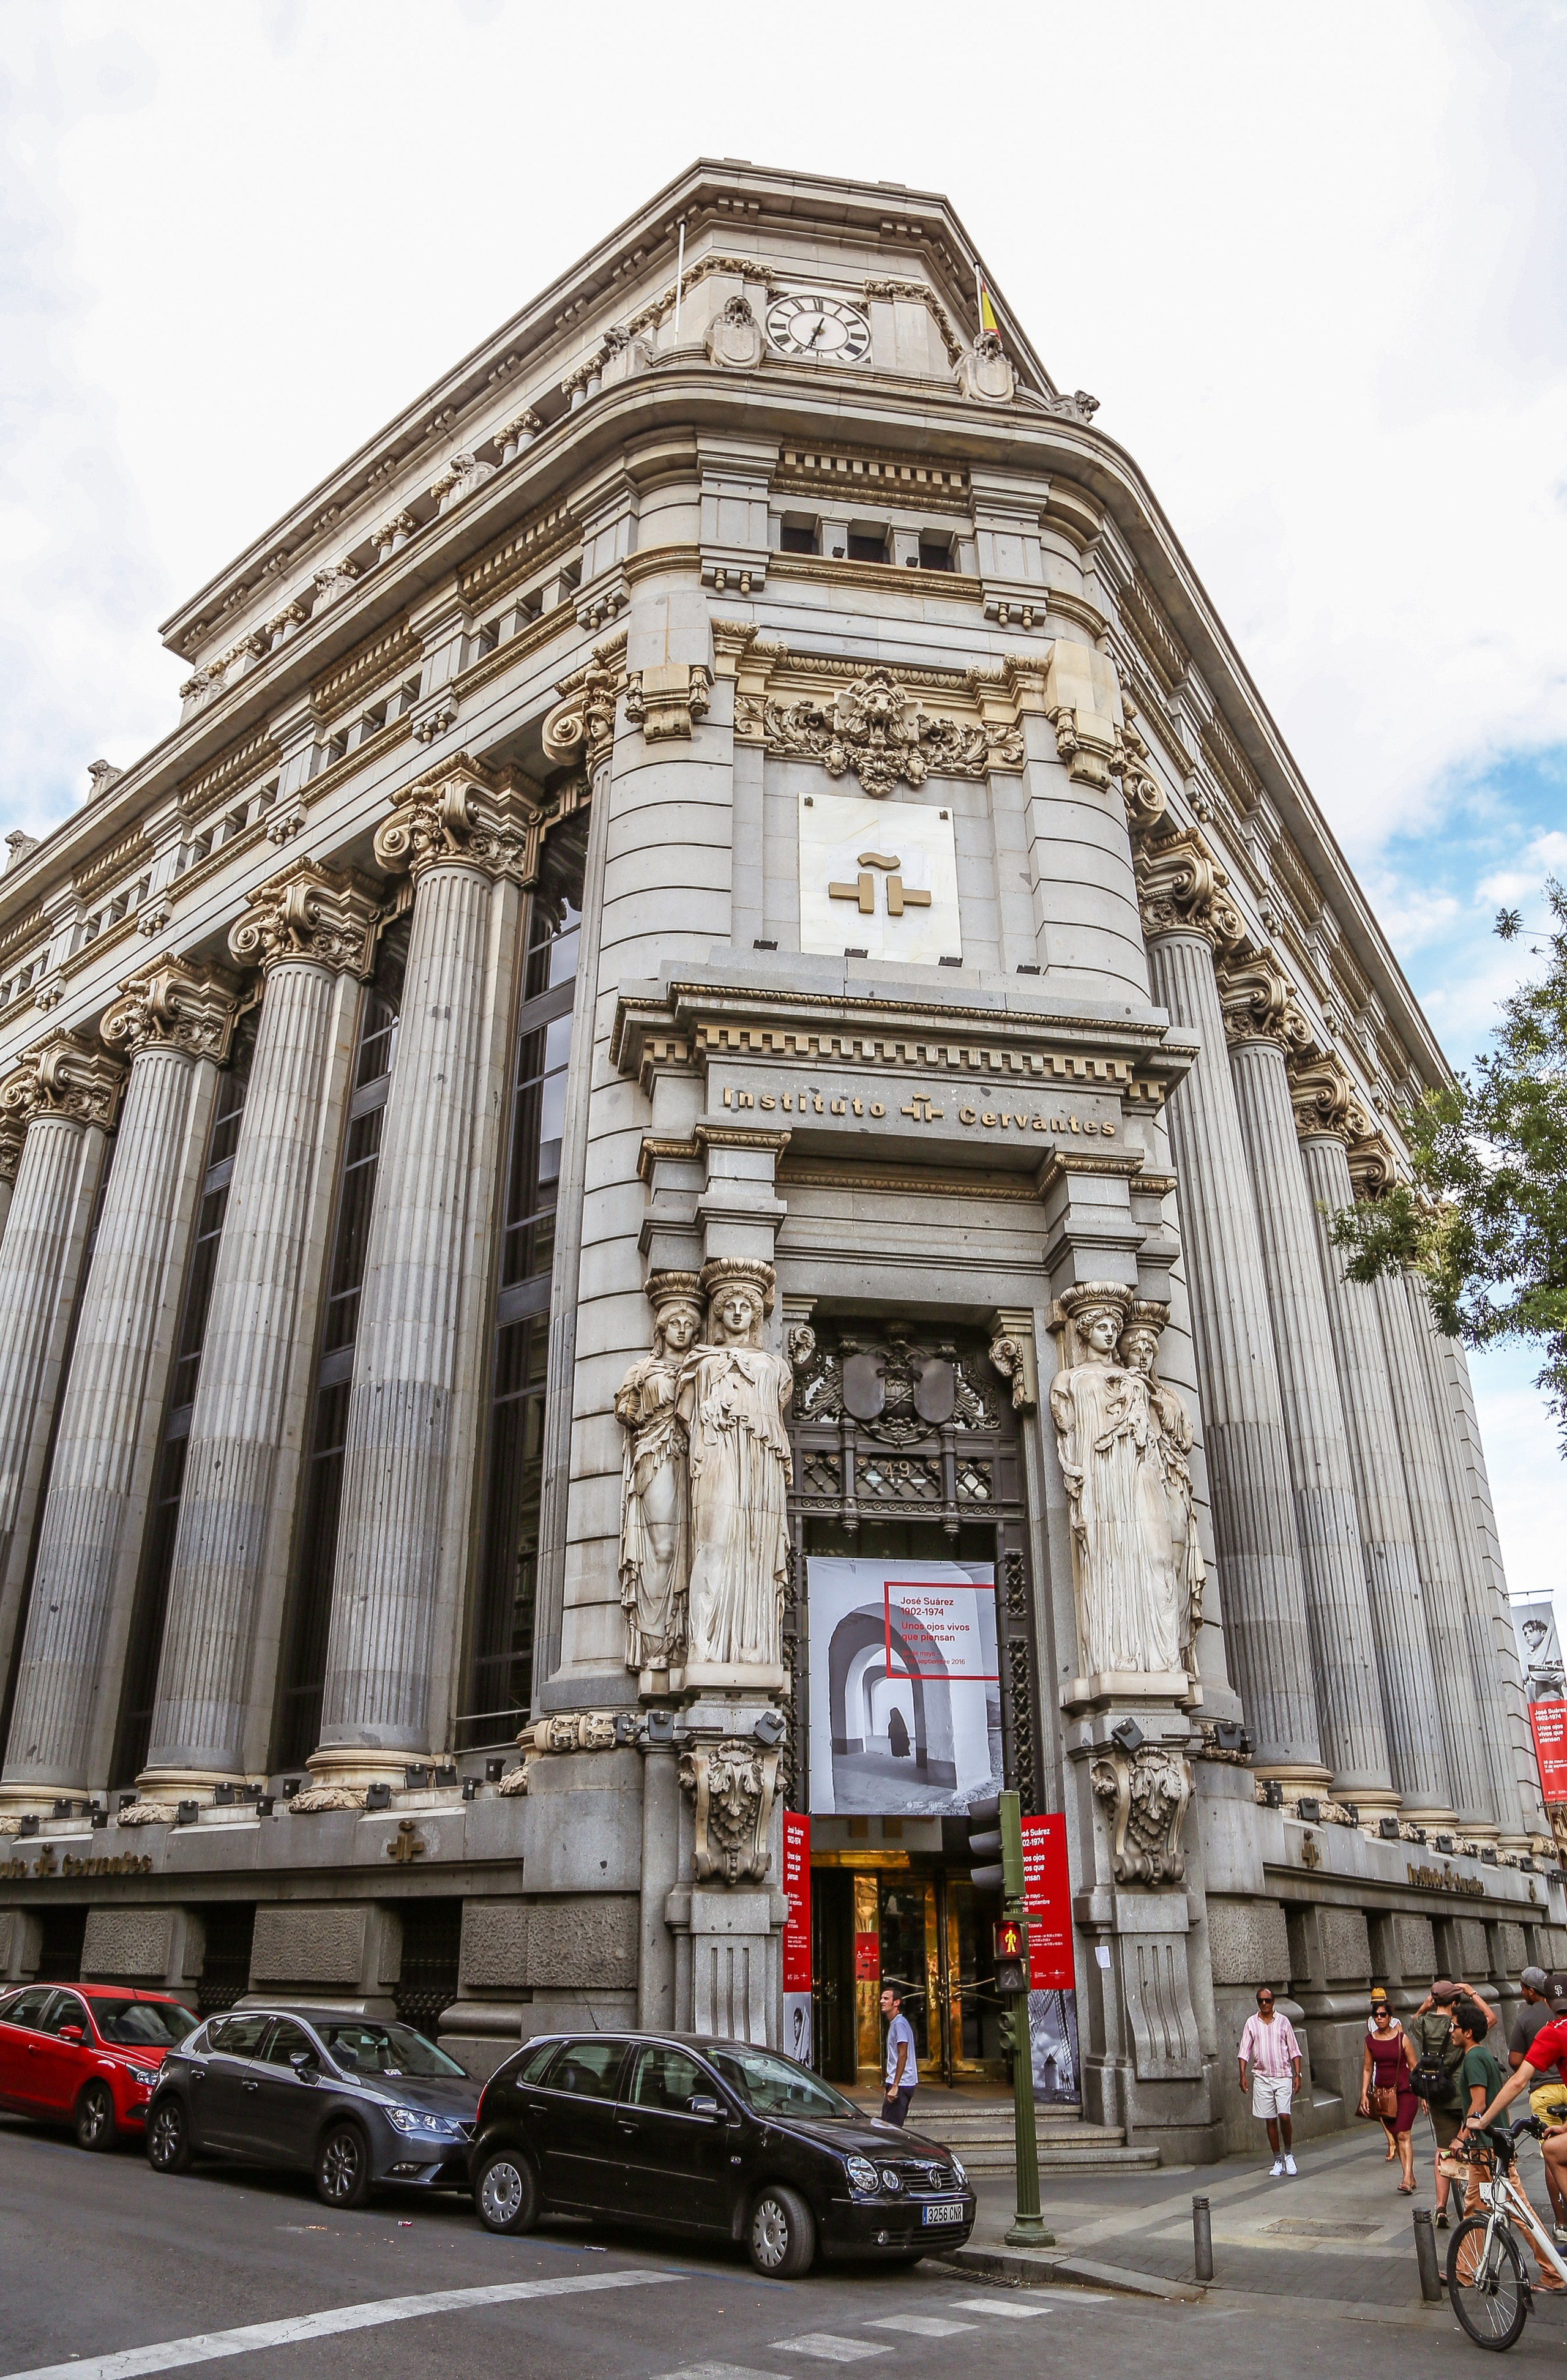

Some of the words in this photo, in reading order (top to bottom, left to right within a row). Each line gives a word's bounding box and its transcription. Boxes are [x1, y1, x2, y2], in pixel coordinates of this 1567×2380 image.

[723, 1086, 886, 1119] Instituto
[959, 1105, 1116, 1137] Cervantes
[884, 1461, 910, 1477] 49
[923, 1597, 954, 1606] Suárez
[900, 1607, 944, 1616] 1902-1974
[901, 1622, 924, 1630] Unos
[926, 1622, 945, 1632] ojos
[901, 1634, 918, 1643] que
[921, 1633, 956, 1643] piensan
[1539, 1736, 1560, 1745] piensan
[1030, 1828, 1050, 1837] Suárez
[1022, 1837, 1044, 1847] 02-1974
[1033, 1853, 1045, 1863] ojos
[62, 1851, 152, 1876] Cervantes
[1033, 1864, 1044, 1873] que
[928, 2205, 948, 2222] 3256
[949, 2204, 962, 2221] CNR
